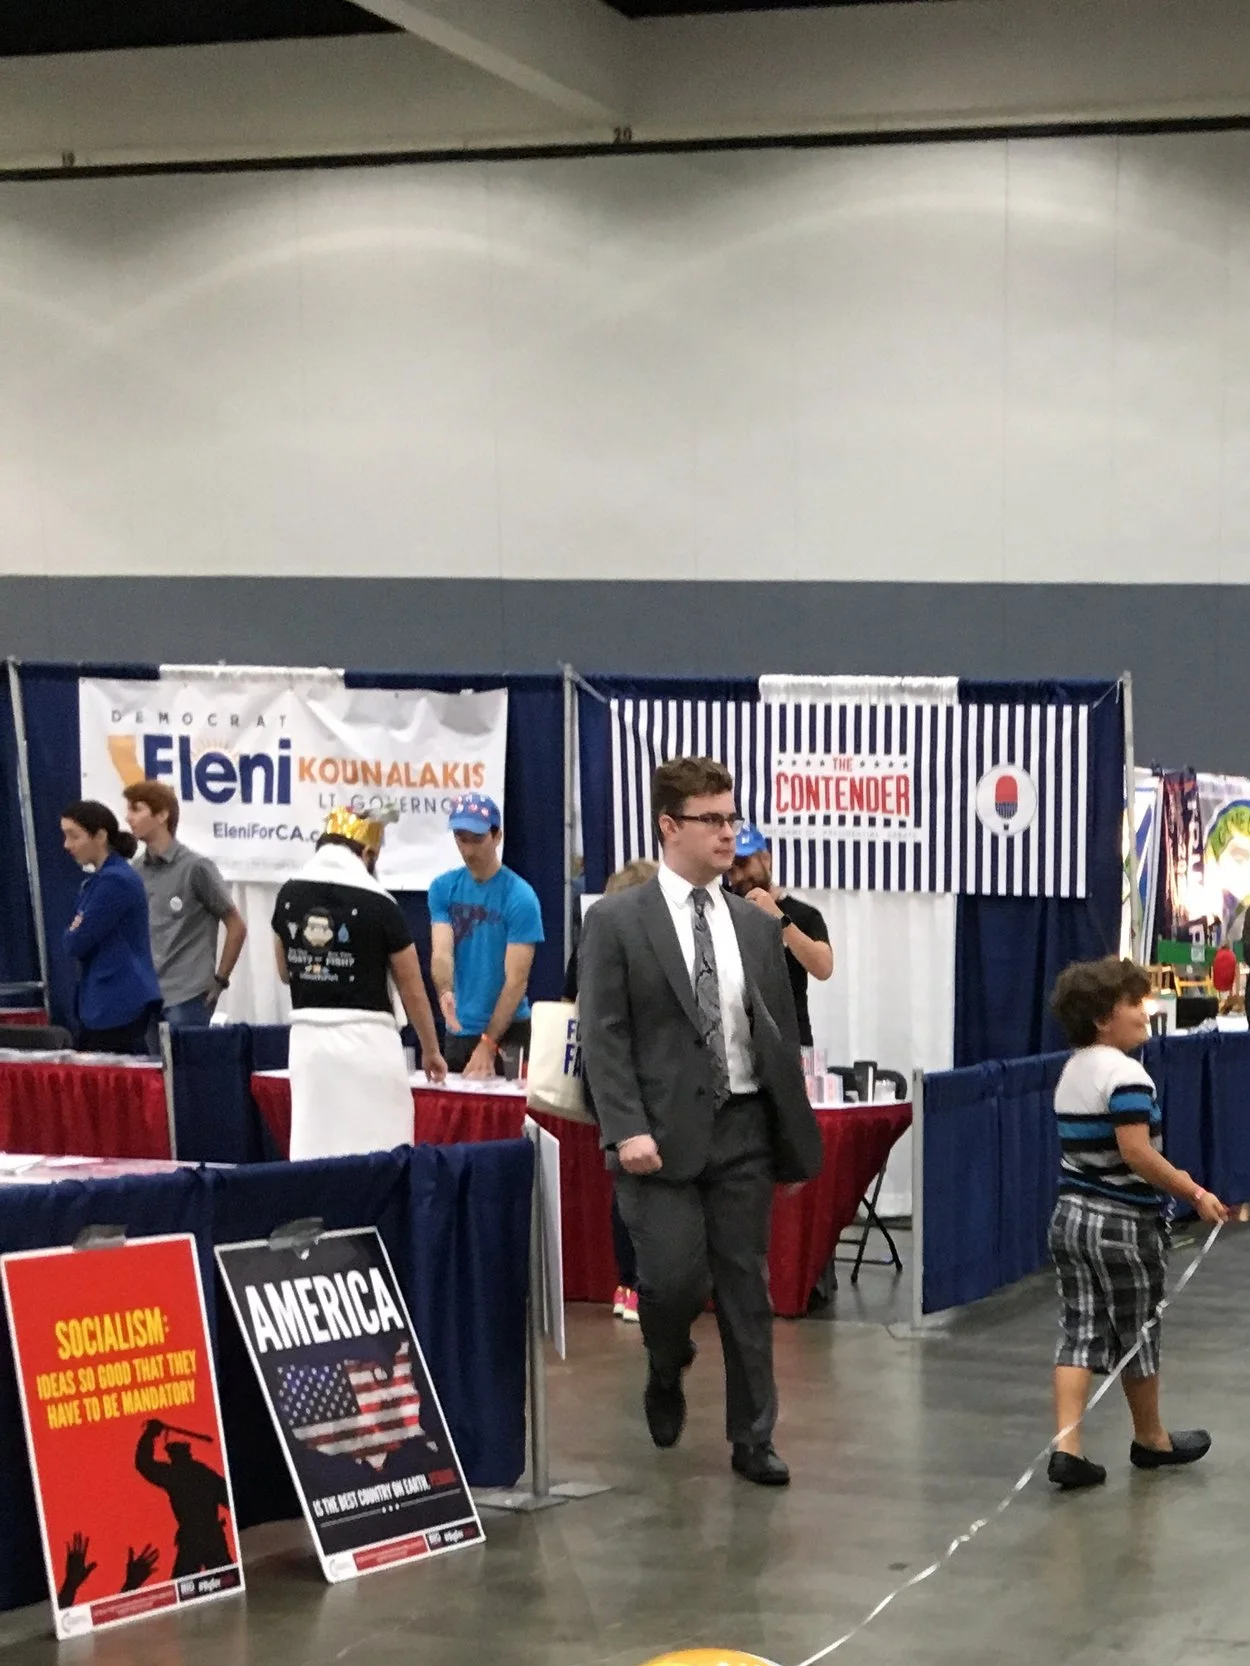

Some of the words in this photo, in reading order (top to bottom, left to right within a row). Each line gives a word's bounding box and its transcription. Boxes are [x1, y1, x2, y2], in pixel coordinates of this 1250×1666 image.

[111, 709, 287, 728] DEMOCRAT
[142, 733, 292, 805] Eleni
[298, 756, 486, 789] KOUNALAKIS
[832, 757, 853, 772] THE
[318, 792, 336, 809] LT
[350, 794, 453, 815] GOVERNO
[775, 771, 911, 817] CONTENDER
[212, 821, 321, 843] EleniForCA.c
[244, 1266, 405, 1354] AMERICA
[54, 1306, 170, 1361] SOCIALISM:
[36, 1369, 77, 1400] IDEAS
[77, 1366, 96, 1393] SO
[97, 1360, 132, 1390] GOOD
[132, 1354, 164, 1383] THAT
[166, 1349, 197, 1377] THEY
[47, 1399, 82, 1429] HAVE
[83, 1396, 101, 1422] TO
[102, 1392, 120, 1419] BE
[120, 1379, 196, 1416] MANDATORY
[312, 1499, 324, 1518] IS
[322, 1495, 340, 1515] THE
[337, 1490, 358, 1512] BEST
[357, 1483, 393, 1506] COUNTRY
[391, 1479, 405, 1498] ON
